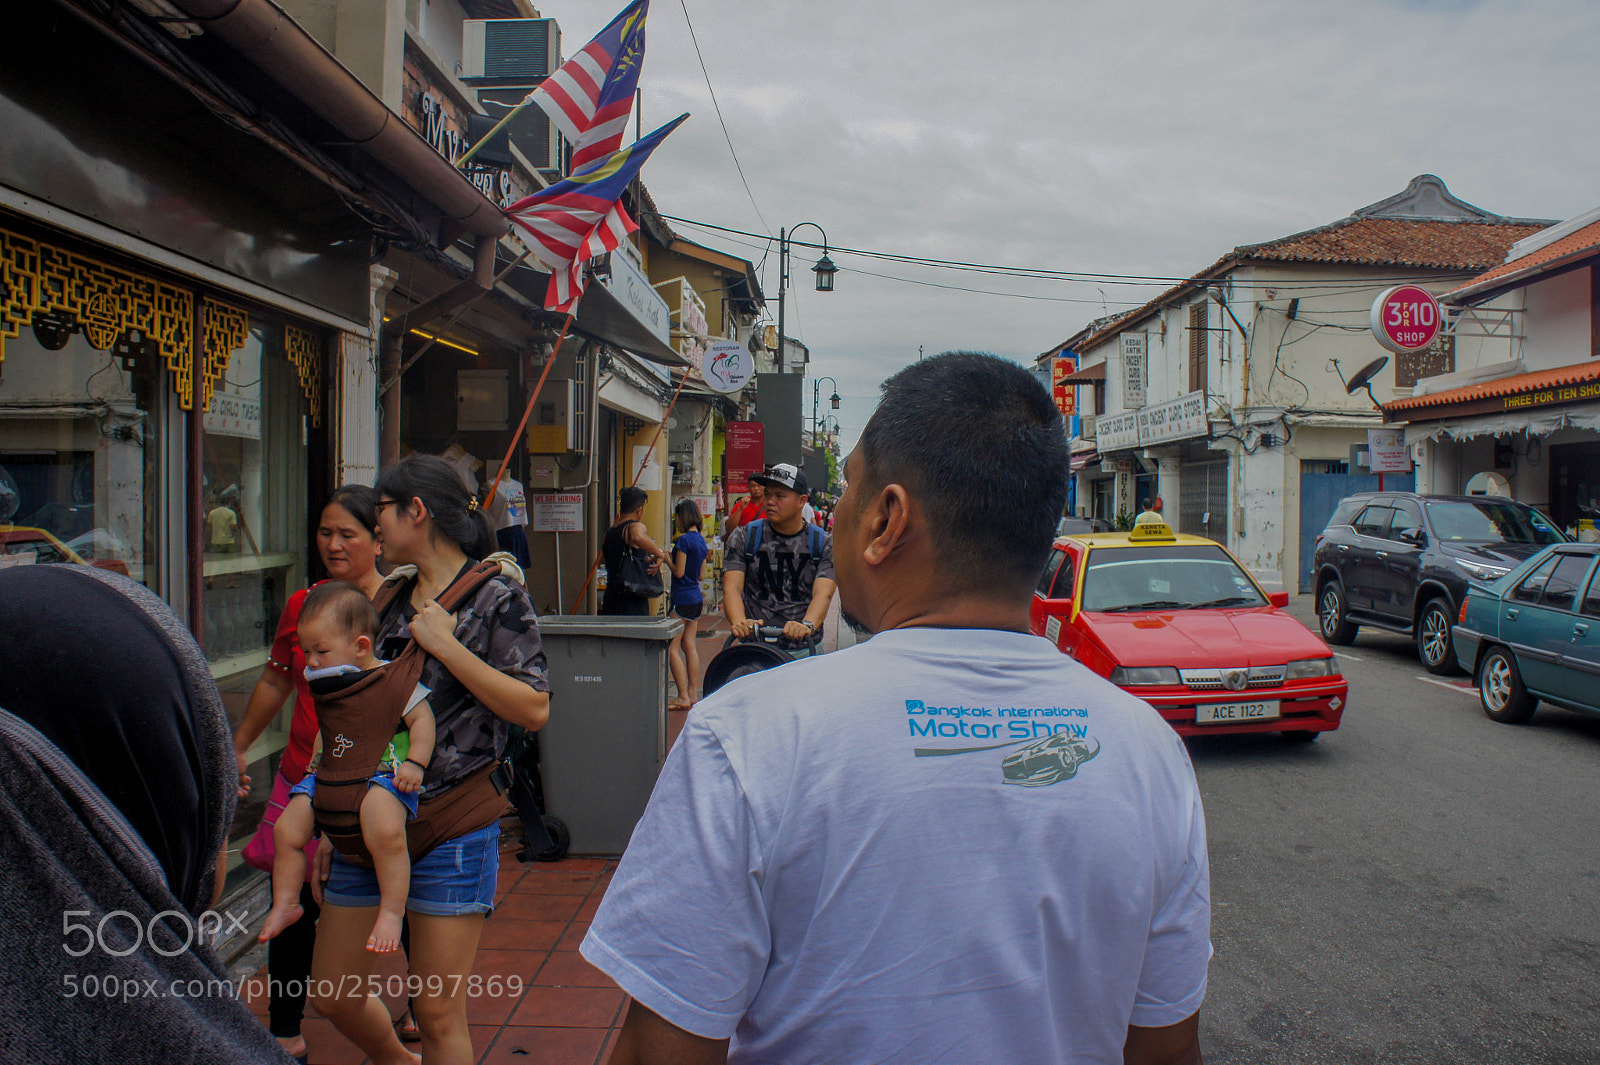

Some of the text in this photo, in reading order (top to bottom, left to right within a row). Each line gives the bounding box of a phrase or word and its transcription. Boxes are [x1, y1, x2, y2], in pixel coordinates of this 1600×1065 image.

[1387, 302, 1402, 326] 3
[1409, 302, 1434, 326] 10
[1396, 332, 1425, 342] SHOP
[1503, 394, 1532, 408] THREE
[1534, 391, 1554, 404] FOR
[1557, 387, 1577, 400] TEN
[1184, 399, 1202, 418] STORE
[905, 699, 1089, 718] Bangkok International
[1212, 704, 1264, 719] ACE 1122
[909, 718, 1088, 739] Motor Show
